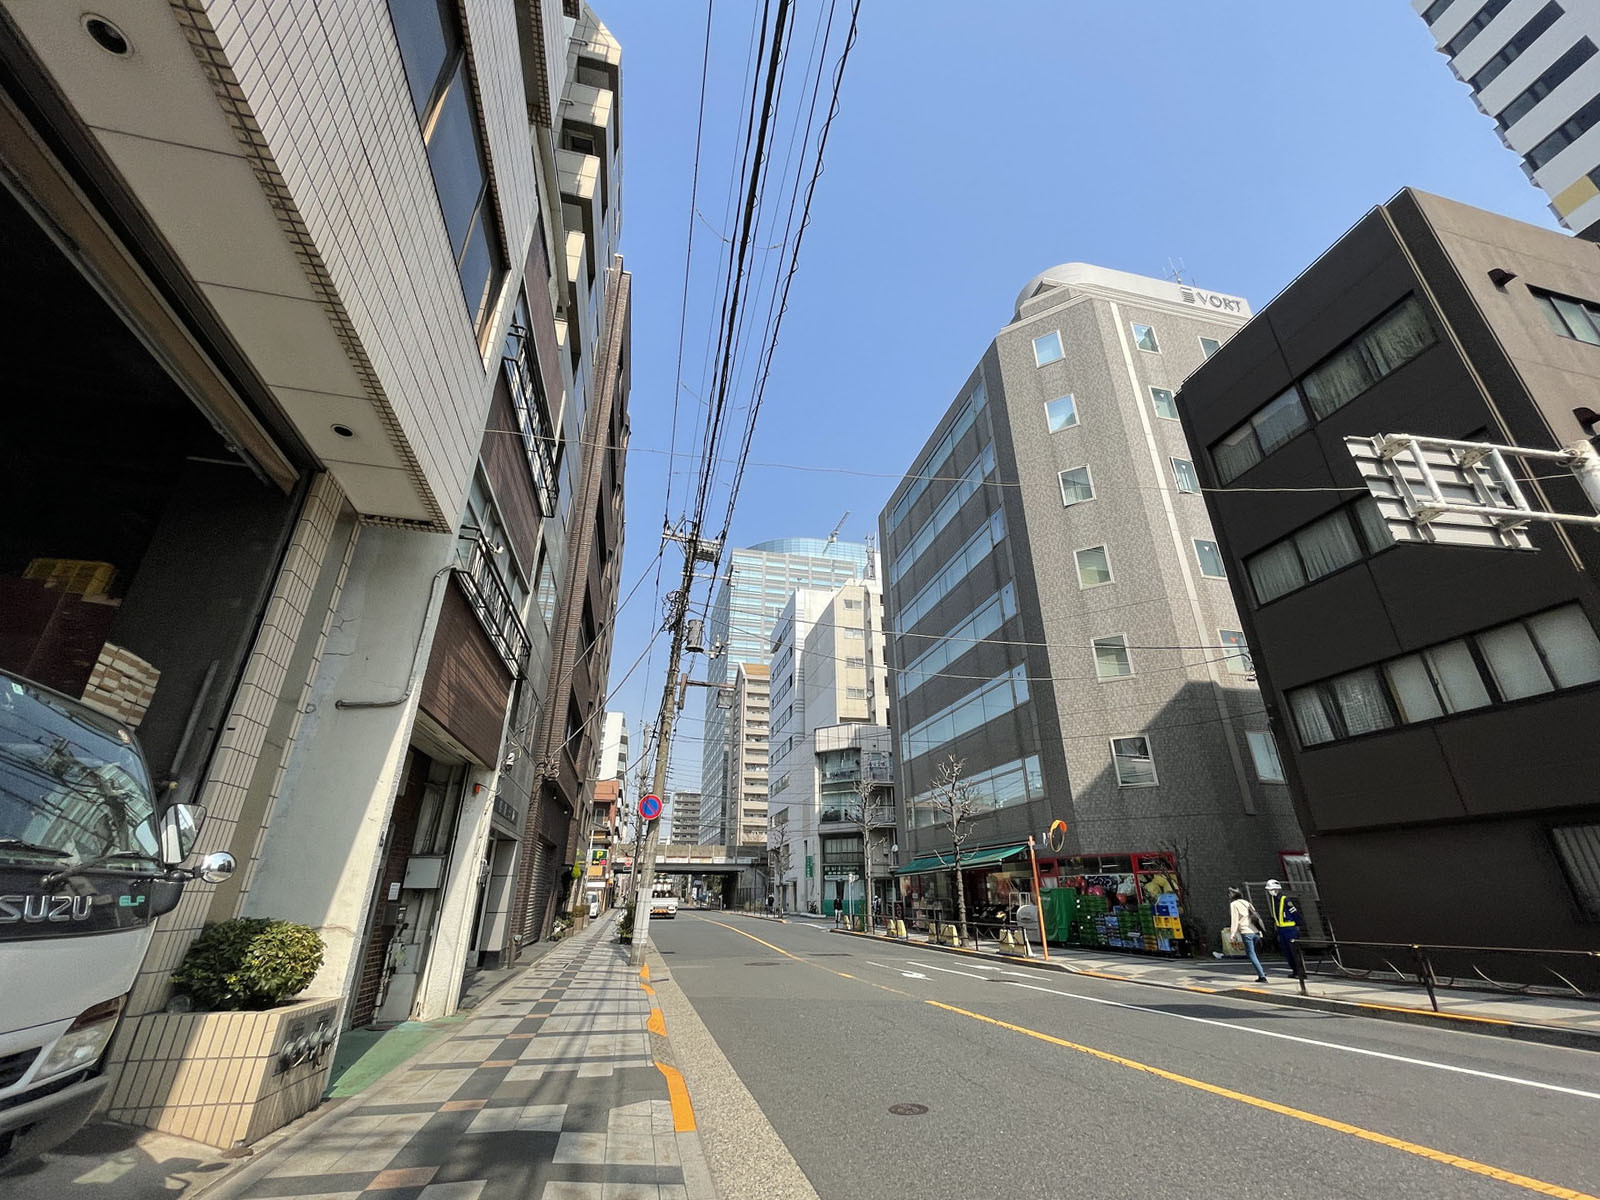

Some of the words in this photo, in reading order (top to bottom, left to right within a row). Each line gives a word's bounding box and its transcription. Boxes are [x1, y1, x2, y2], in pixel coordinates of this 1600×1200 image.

[1196, 291, 1241, 312] VORT
[596, 850, 604, 859] P
[118, 895, 146, 907] ELF
